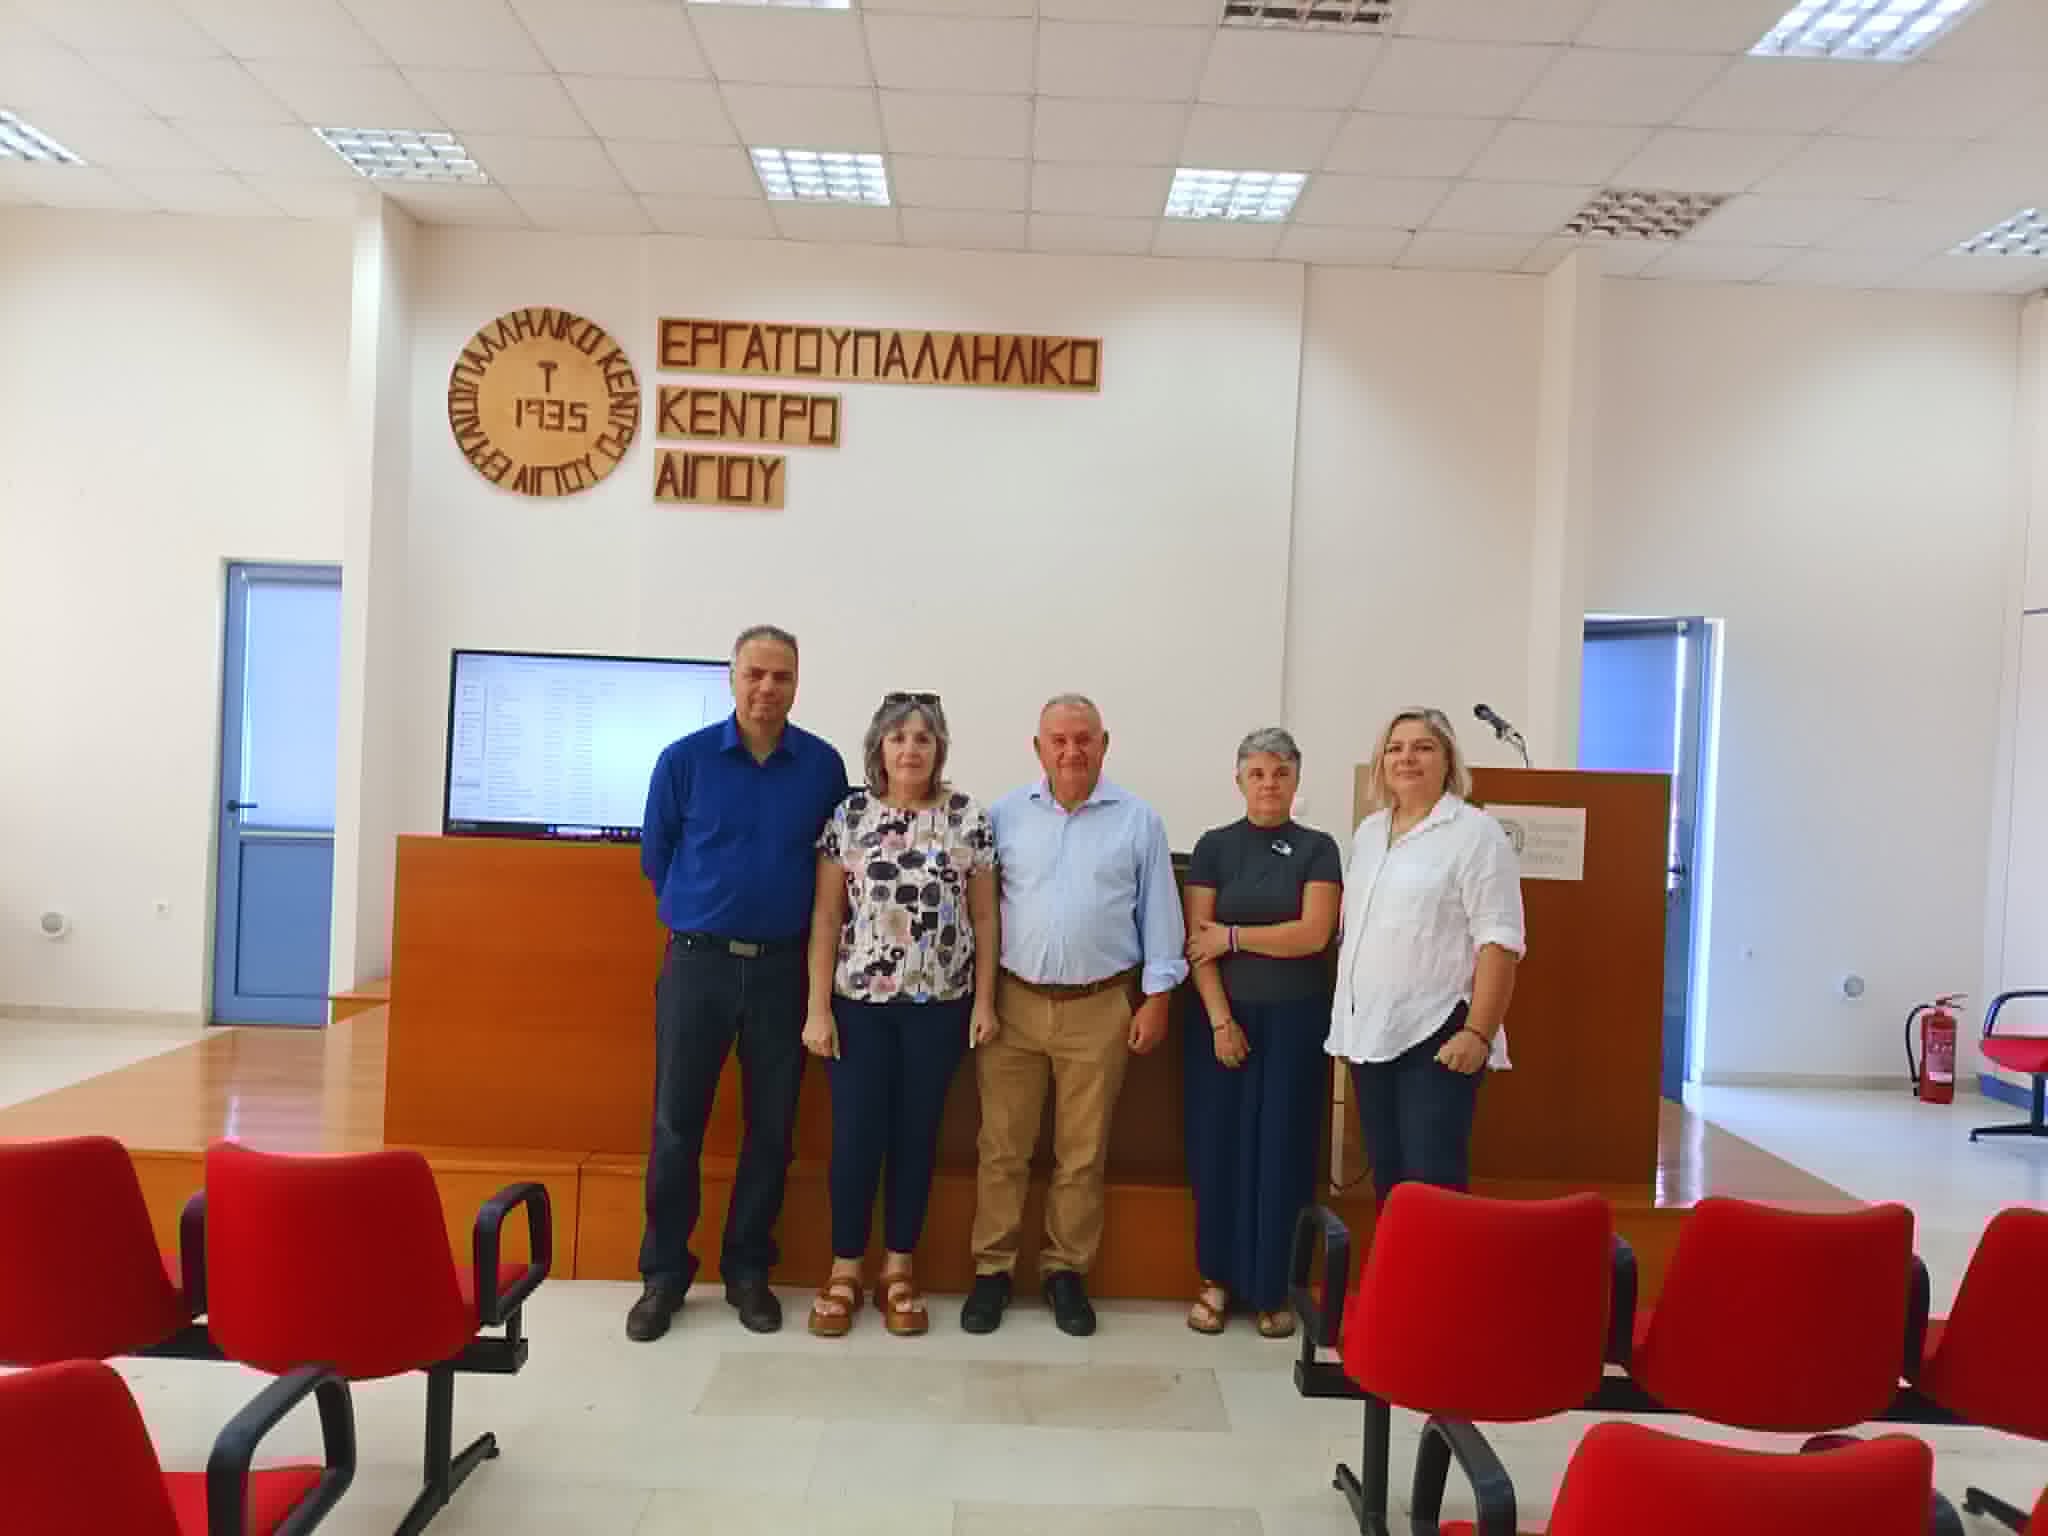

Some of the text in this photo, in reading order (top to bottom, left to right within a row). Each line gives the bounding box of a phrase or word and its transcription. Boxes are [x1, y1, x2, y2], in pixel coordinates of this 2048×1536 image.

[661, 319, 1098, 387] ΕΡΓΑΤΟΥΠΑΛΛΗΛΙΚΟ
[514, 398, 588, 432] 1935
[658, 387, 838, 444] ΚΕΝΤΡΟ
[655, 452, 781, 503] ΑΙΓΙΟΥ
